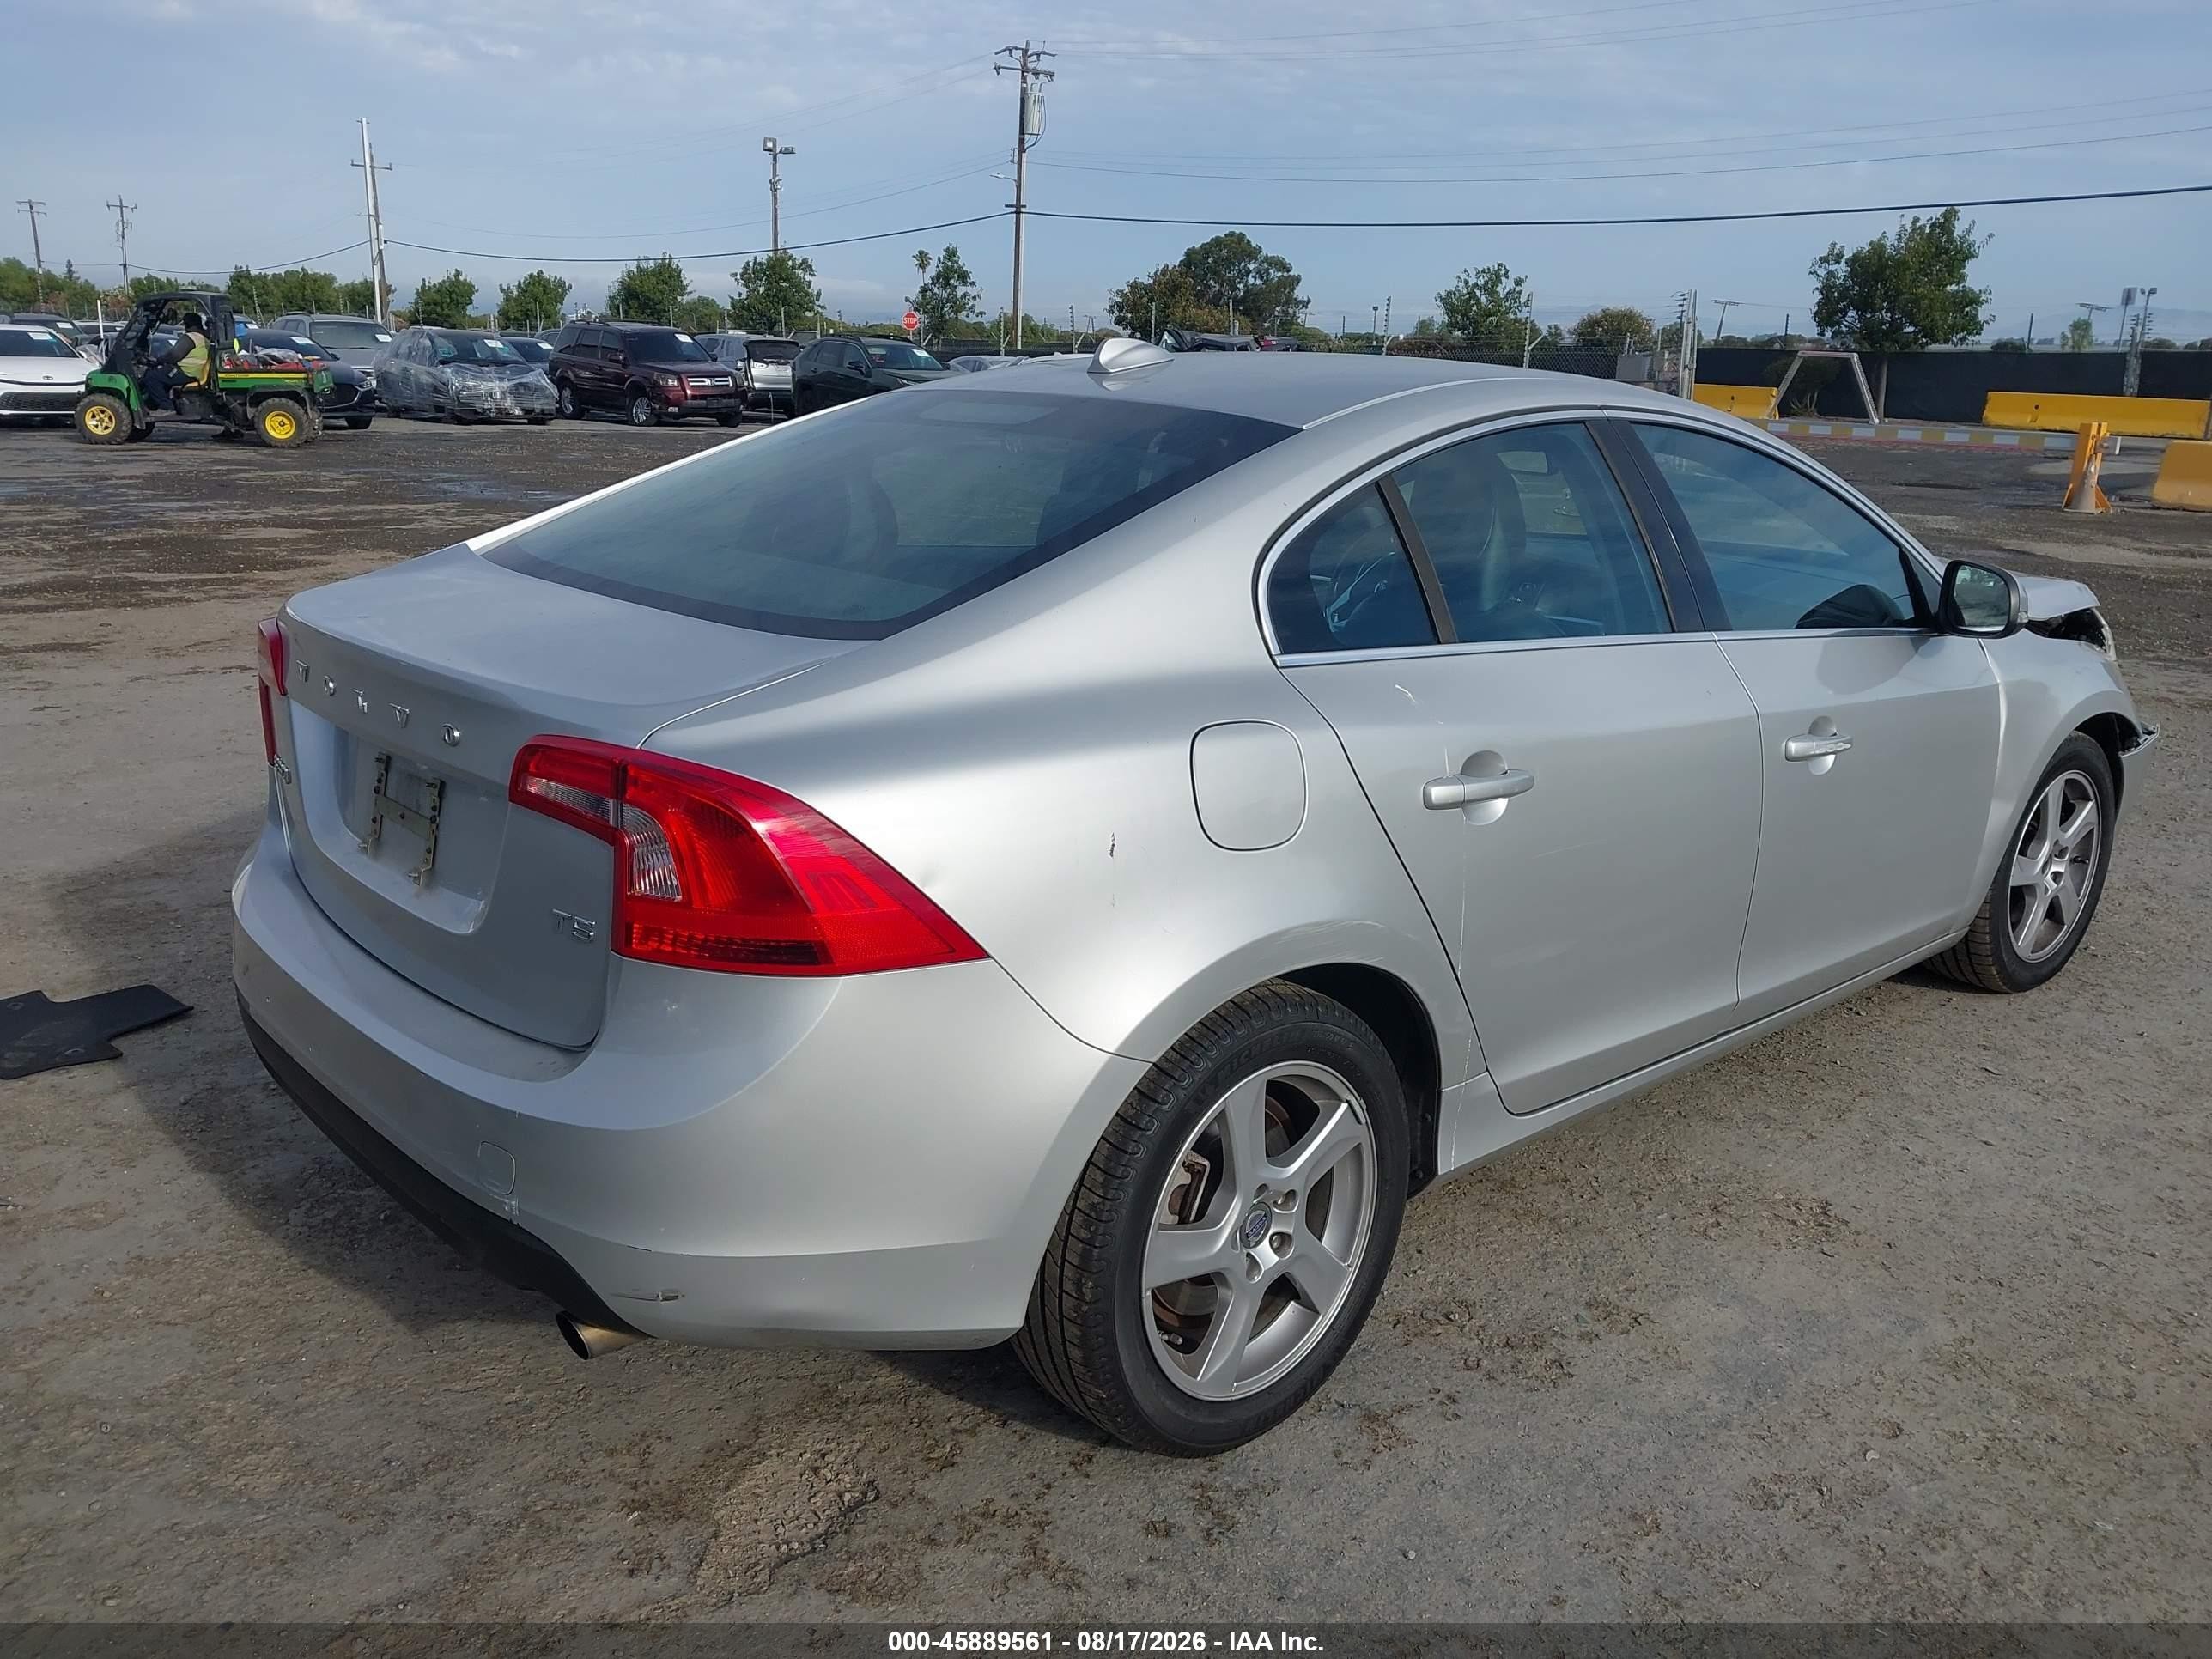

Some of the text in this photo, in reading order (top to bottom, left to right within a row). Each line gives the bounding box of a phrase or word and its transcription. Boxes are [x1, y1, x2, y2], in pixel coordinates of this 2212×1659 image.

[295, 659, 461, 747] VOLVO
[552, 908, 598, 943] T5
[1248, 1217, 1267, 1237] VOLVO
